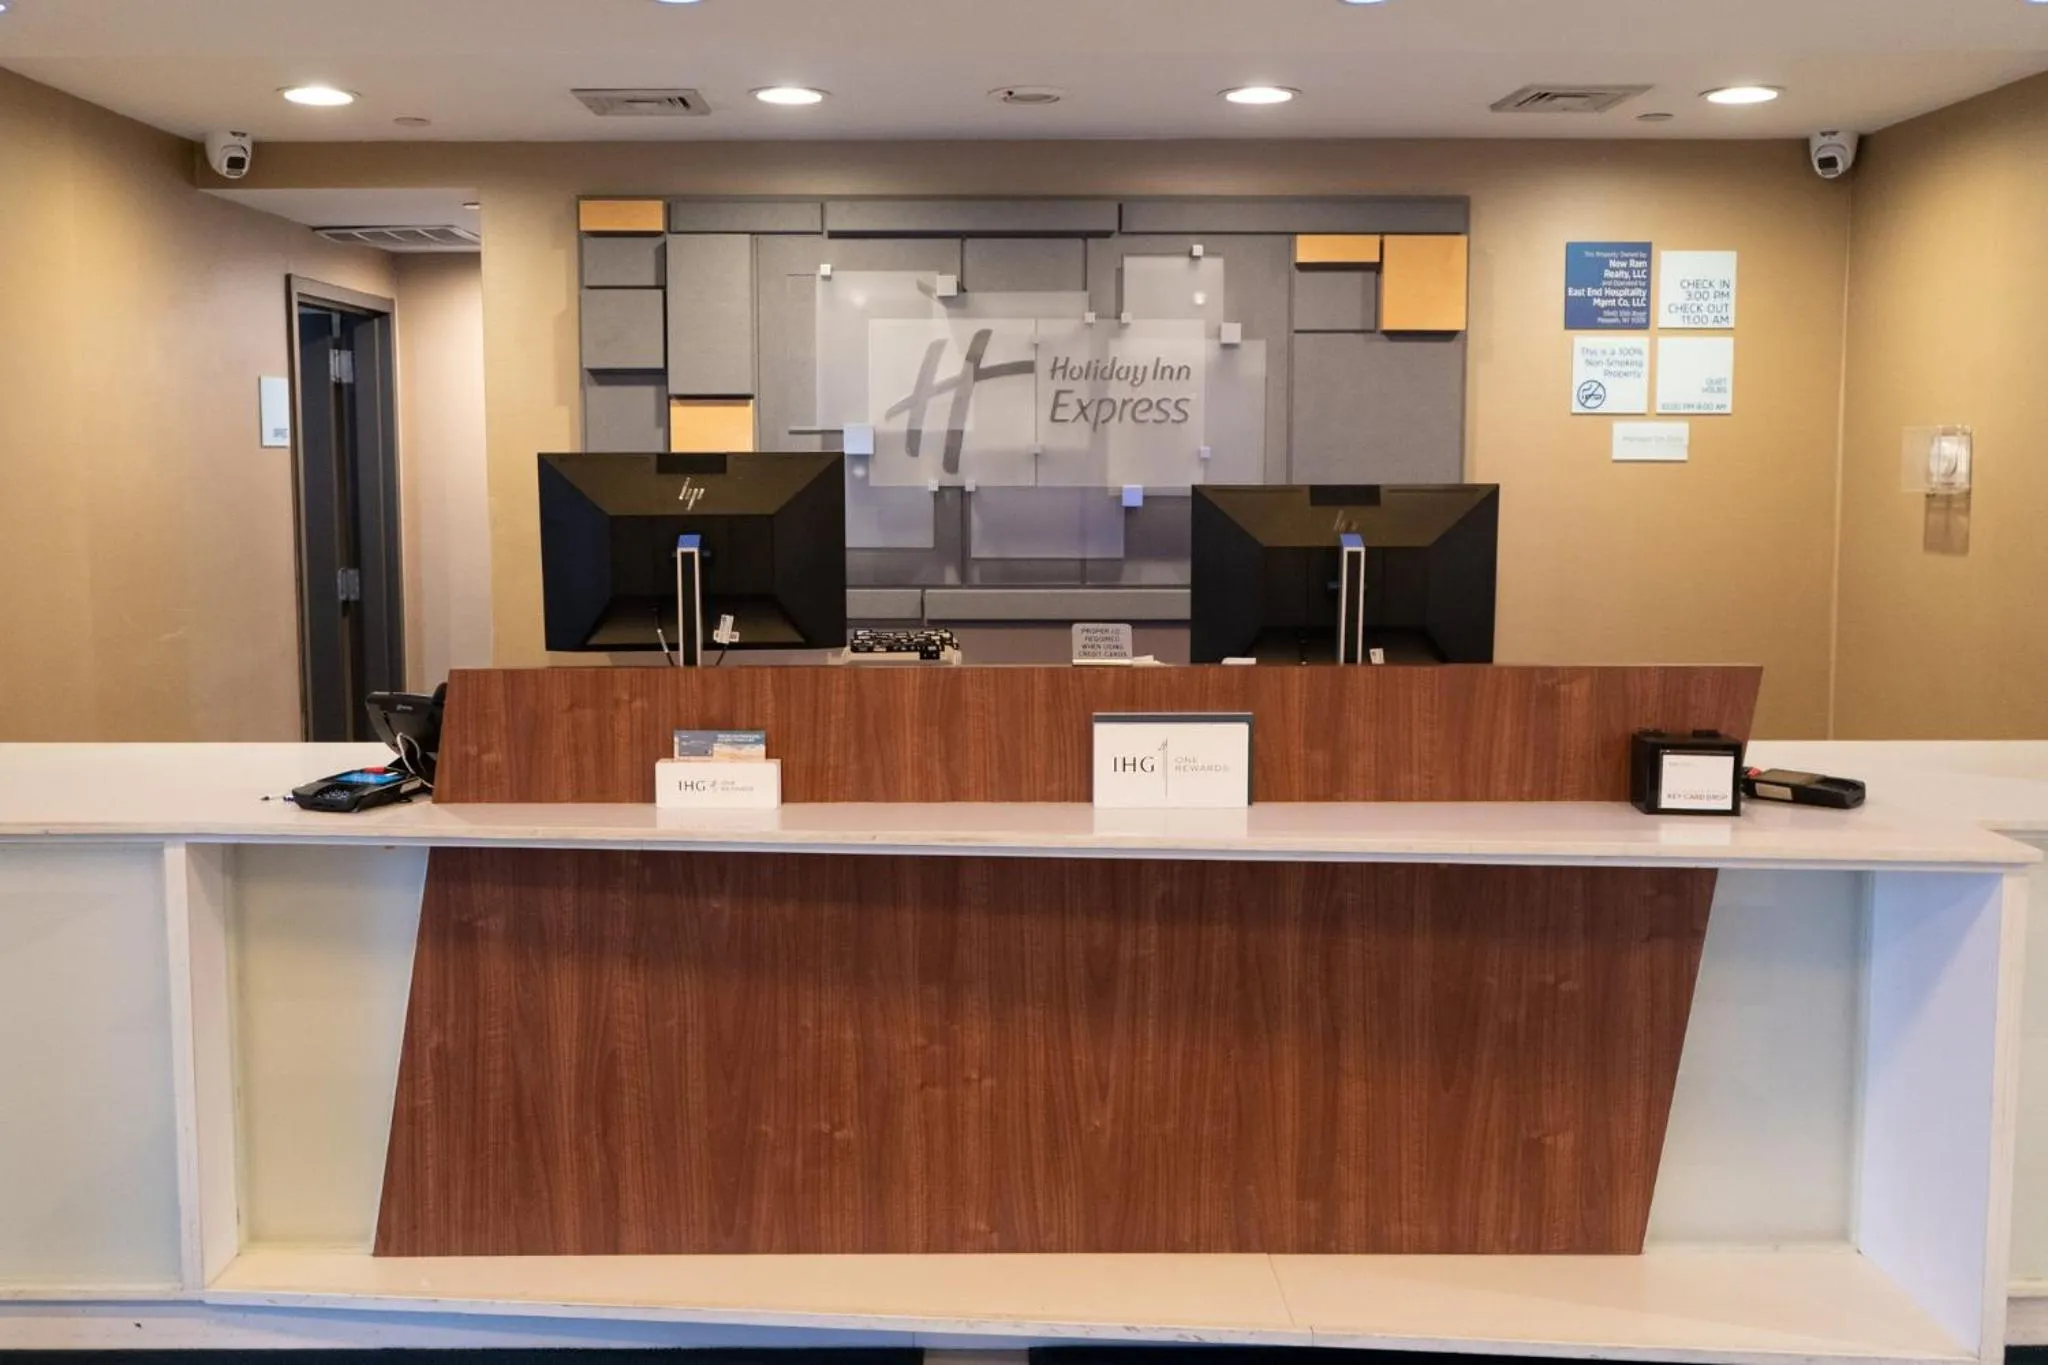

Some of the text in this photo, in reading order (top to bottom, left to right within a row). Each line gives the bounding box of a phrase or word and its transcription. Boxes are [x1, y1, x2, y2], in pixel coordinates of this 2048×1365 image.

[1609, 259, 1628, 268] New
[1603, 270, 1647, 280] Realty, LLC
[1680, 279, 1731, 290] CHECK IN
[1568, 287, 1647, 298] East End Hospitality
[1713, 290, 1731, 301] PM
[1592, 298, 1616, 308] Mgmt
[1632, 298, 1647, 307] LLC
[1668, 303, 1730, 314] CHECK OUT
[1712, 315, 1730, 325] AM
[1050, 356, 1192, 388] Holiday Inn
[1603, 369, 1642, 379] Property
[1050, 389, 1191, 433] Express
[678, 476, 705, 512] hp
[1113, 756, 1155, 773] IHG
[1174, 764, 1229, 773] REWARDS
[678, 780, 706, 792] IHG
